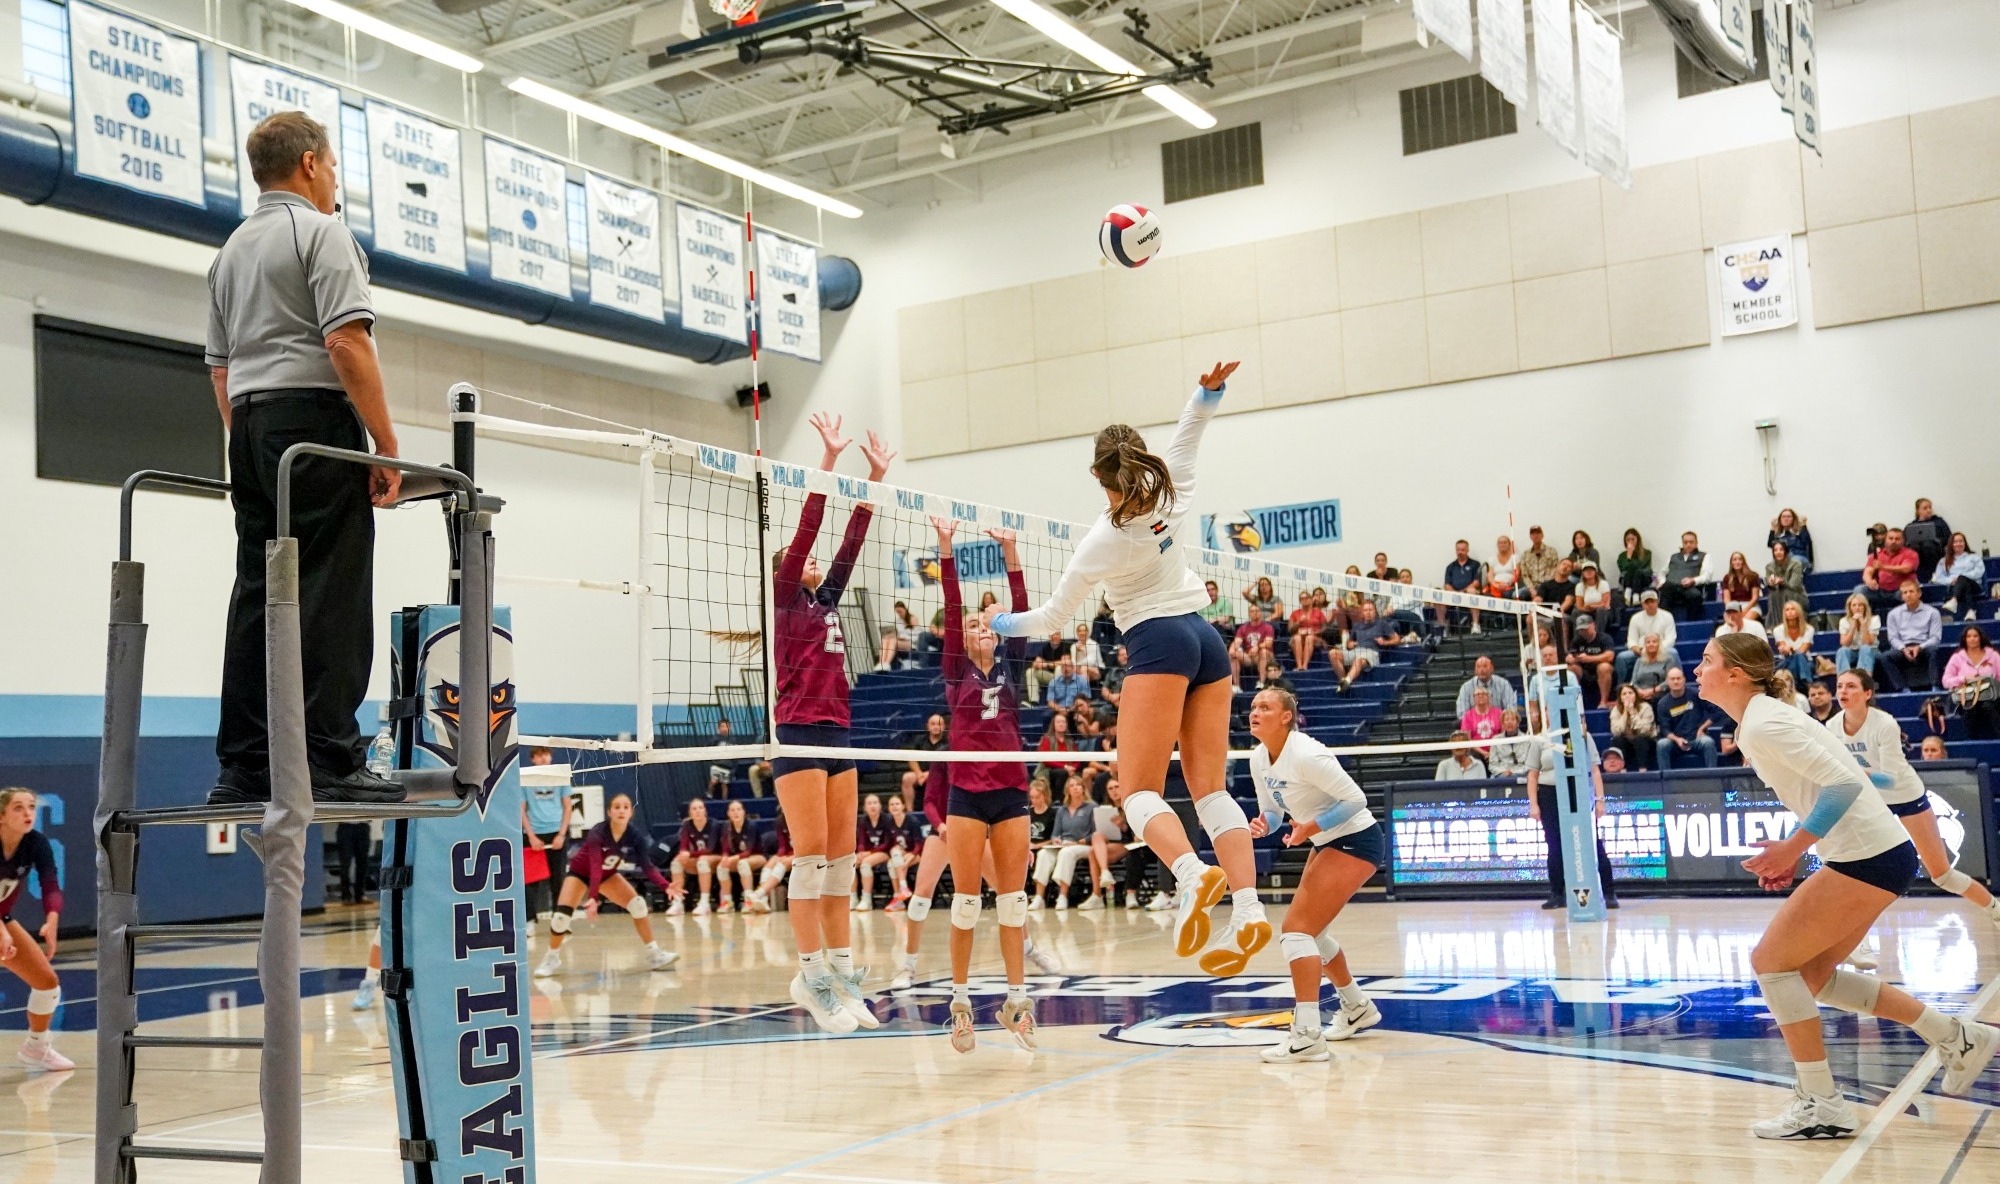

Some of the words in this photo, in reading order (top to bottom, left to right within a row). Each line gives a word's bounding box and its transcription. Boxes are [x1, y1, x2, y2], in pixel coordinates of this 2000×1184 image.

[108, 26, 162, 62] STATE
[89, 49, 184, 97] CHAMPIONS
[265, 79, 310, 108] STATE
[94, 114, 186, 159] SOFTBALL
[395, 121, 433, 150] STATE
[121, 153, 163, 182] 2016
[382, 142, 449, 178] CHAMPIONS
[510, 157, 542, 182] STATE
[496, 176, 559, 211] CHAMPIONS
[398, 202, 438, 228] CHEER
[597, 209, 650, 239] CHAMPIONS
[404, 230, 436, 253] 2016
[696, 219, 724, 241] STATE
[517, 233, 569, 263] BASKETBALL
[687, 238, 736, 266] CHAMPIONS
[1724, 247, 1782, 267] CHSAA
[520, 259, 544, 280] 2017
[616, 285, 640, 304] 2017
[692, 284, 737, 311] BASEBALL
[1733, 295, 1781, 311] MEMBER
[704, 309, 726, 327] 2017
[778, 309, 804, 328] CHEER
[1735, 309, 1782, 325] SCHOOL
[700, 444, 737, 474] VALOR
[772, 464, 806, 489] VALOR
[837, 476, 868, 501] VALOR
[896, 489, 924, 512] VALOR
[951, 501, 977, 523] VALOR
[1001, 510, 1025, 531] VALOR
[1047, 520, 1070, 541] VALOR
[761, 477, 770, 532] PORTER
[1260, 504, 1338, 546] VISITOR
[824, 611, 845, 653] 2
[981, 686, 1002, 720] 5
[1394, 818, 1491, 863] VALOR
